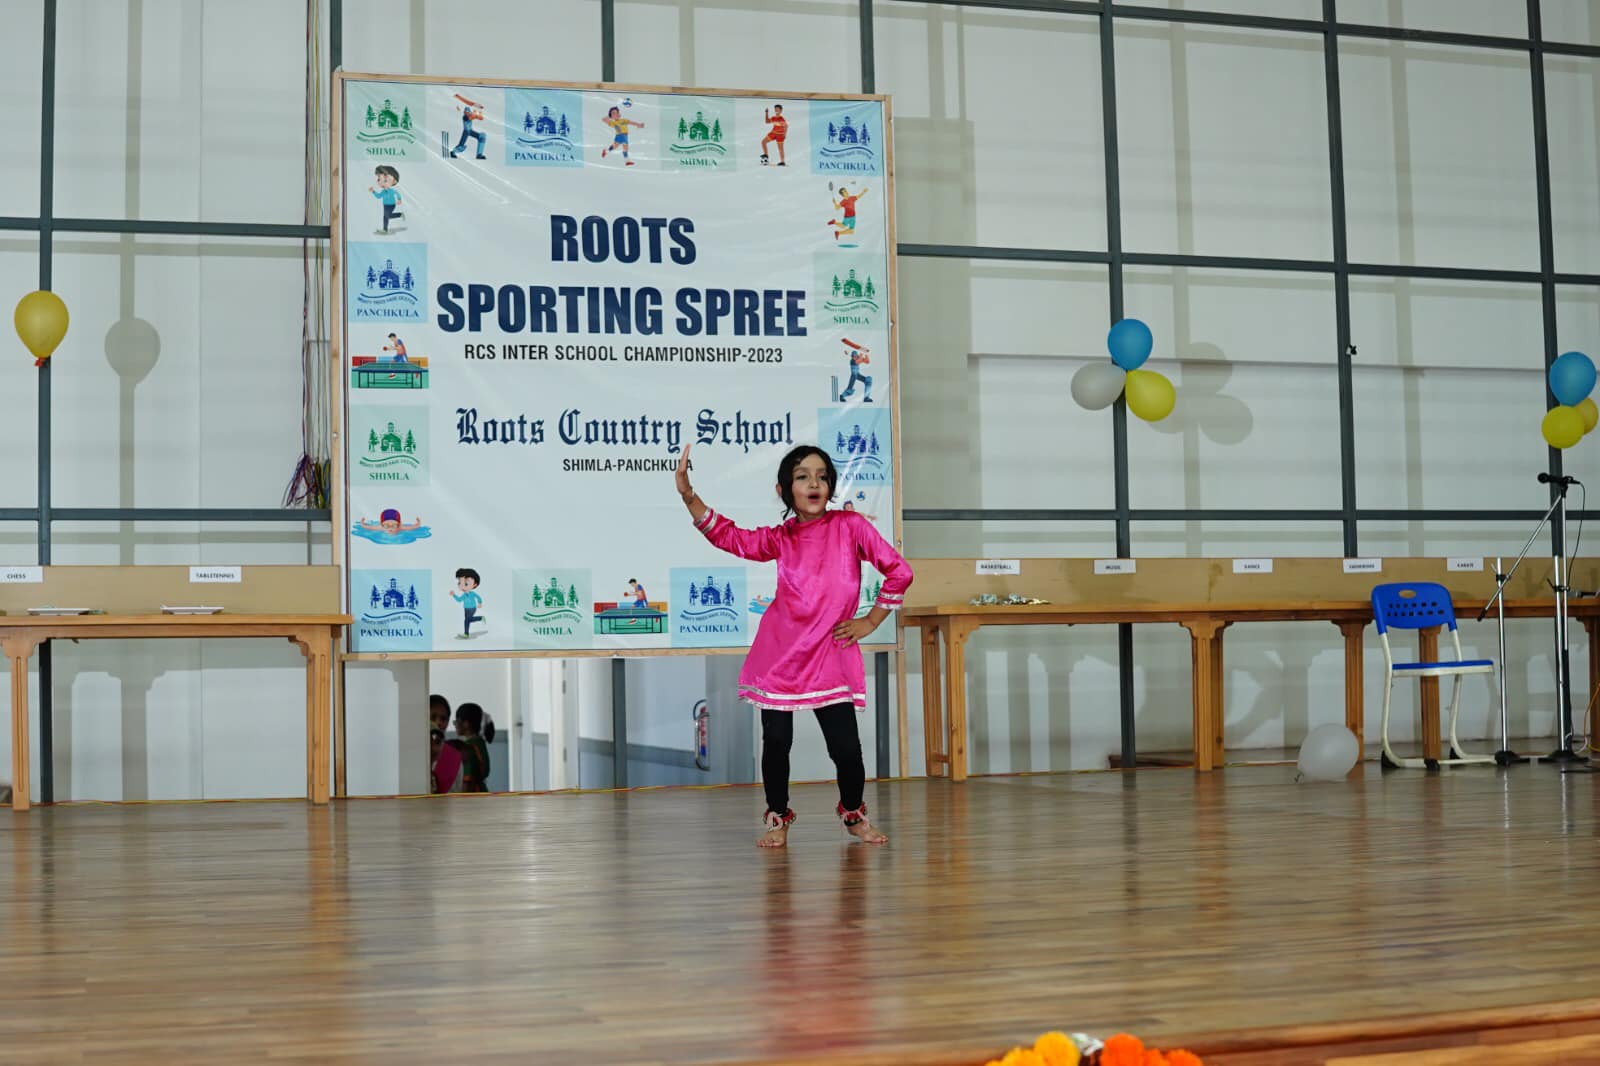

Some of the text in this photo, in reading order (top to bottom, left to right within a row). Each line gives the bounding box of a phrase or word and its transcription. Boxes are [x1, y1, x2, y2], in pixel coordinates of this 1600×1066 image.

[366, 147, 406, 156] SHIMLA
[514, 151, 576, 161] PANCHKULA
[680, 158, 718, 167] SHIMLA
[820, 161, 876, 172] PANCHKULA
[551, 215, 696, 265] ROOTS
[357, 308, 419, 318] PANCHKULA
[437, 283, 807, 336] SPORTING SPREE
[834, 316, 870, 325] SHIMLA
[465, 344, 782, 362] RCS INTER SCHOOL CHAMPIONSHIP-2023
[456, 408, 794, 454] Roots Country School
[562, 458, 694, 472] SHIMLA-PANCHKUA
[370, 472, 410, 481] SHIMLA
[361, 628, 424, 637] PANCHKULA
[533, 626, 573, 636] SHIMLA
[680, 624, 739, 633] PANCHKULA
